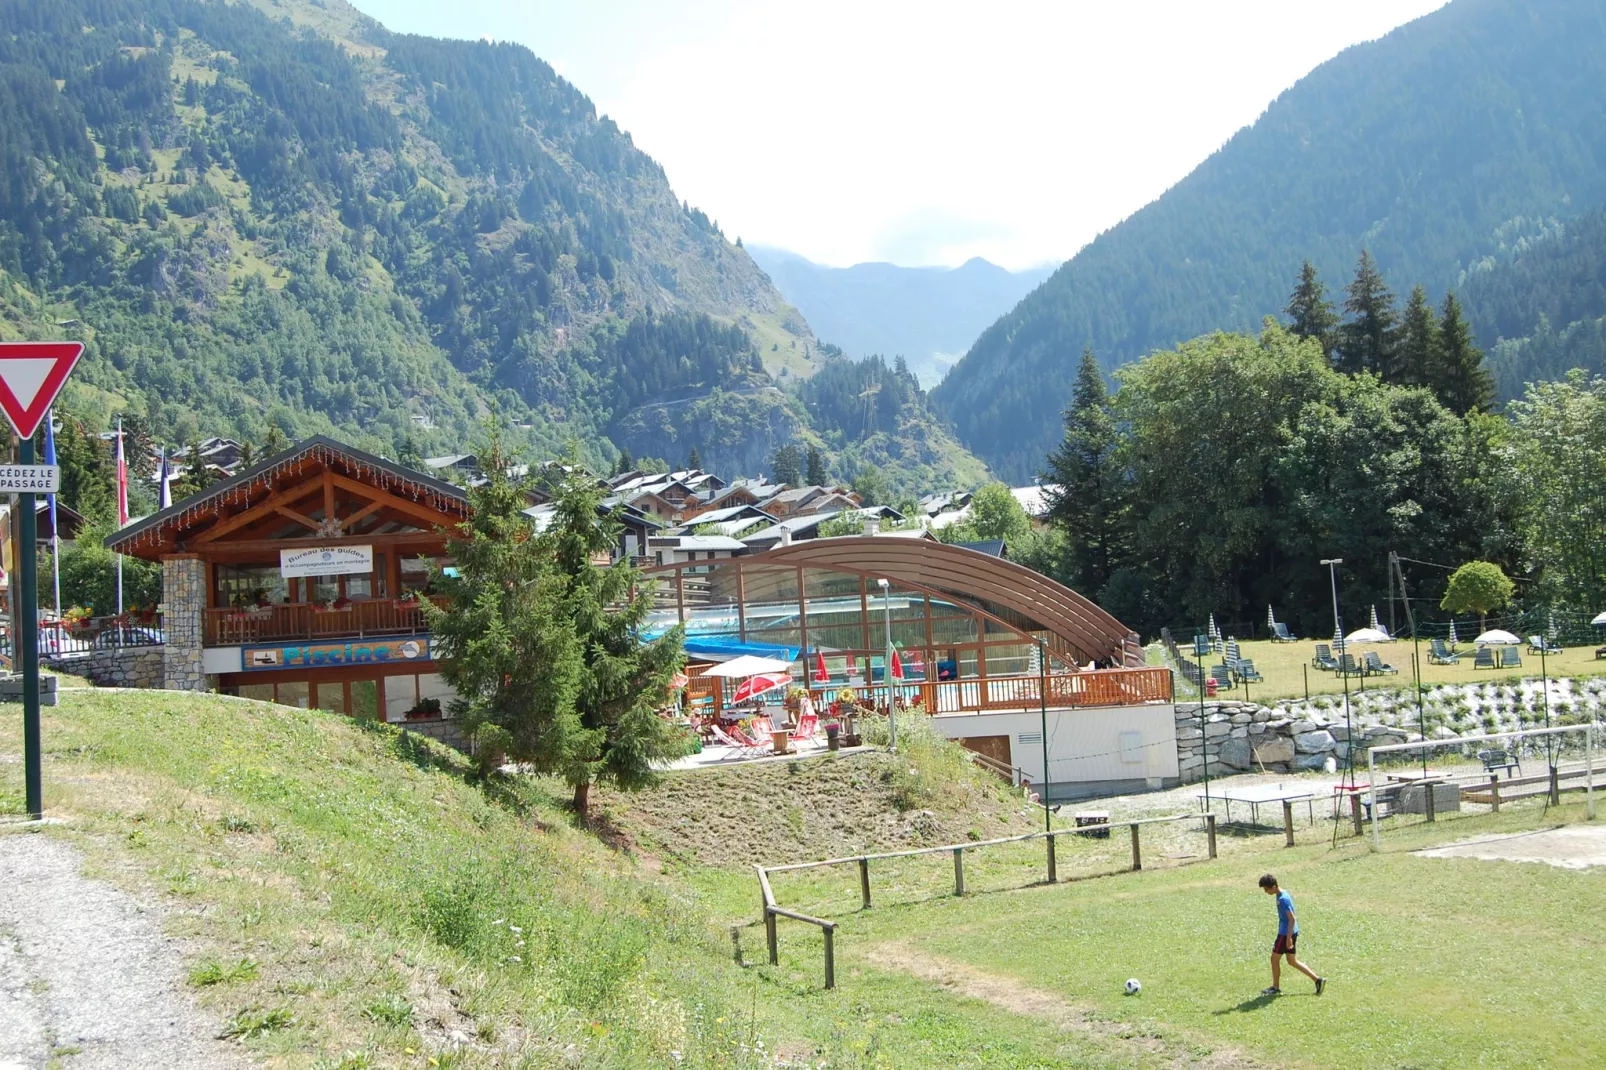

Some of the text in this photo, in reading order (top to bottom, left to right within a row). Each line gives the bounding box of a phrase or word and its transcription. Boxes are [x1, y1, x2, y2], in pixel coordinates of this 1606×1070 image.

[0, 468, 53, 478] CÉDEZ LE
[0, 480, 52, 488] PASSAGE
[288, 550, 318, 563] Bureau
[338, 548, 365, 558] guides
[282, 644, 390, 665] Piscine
